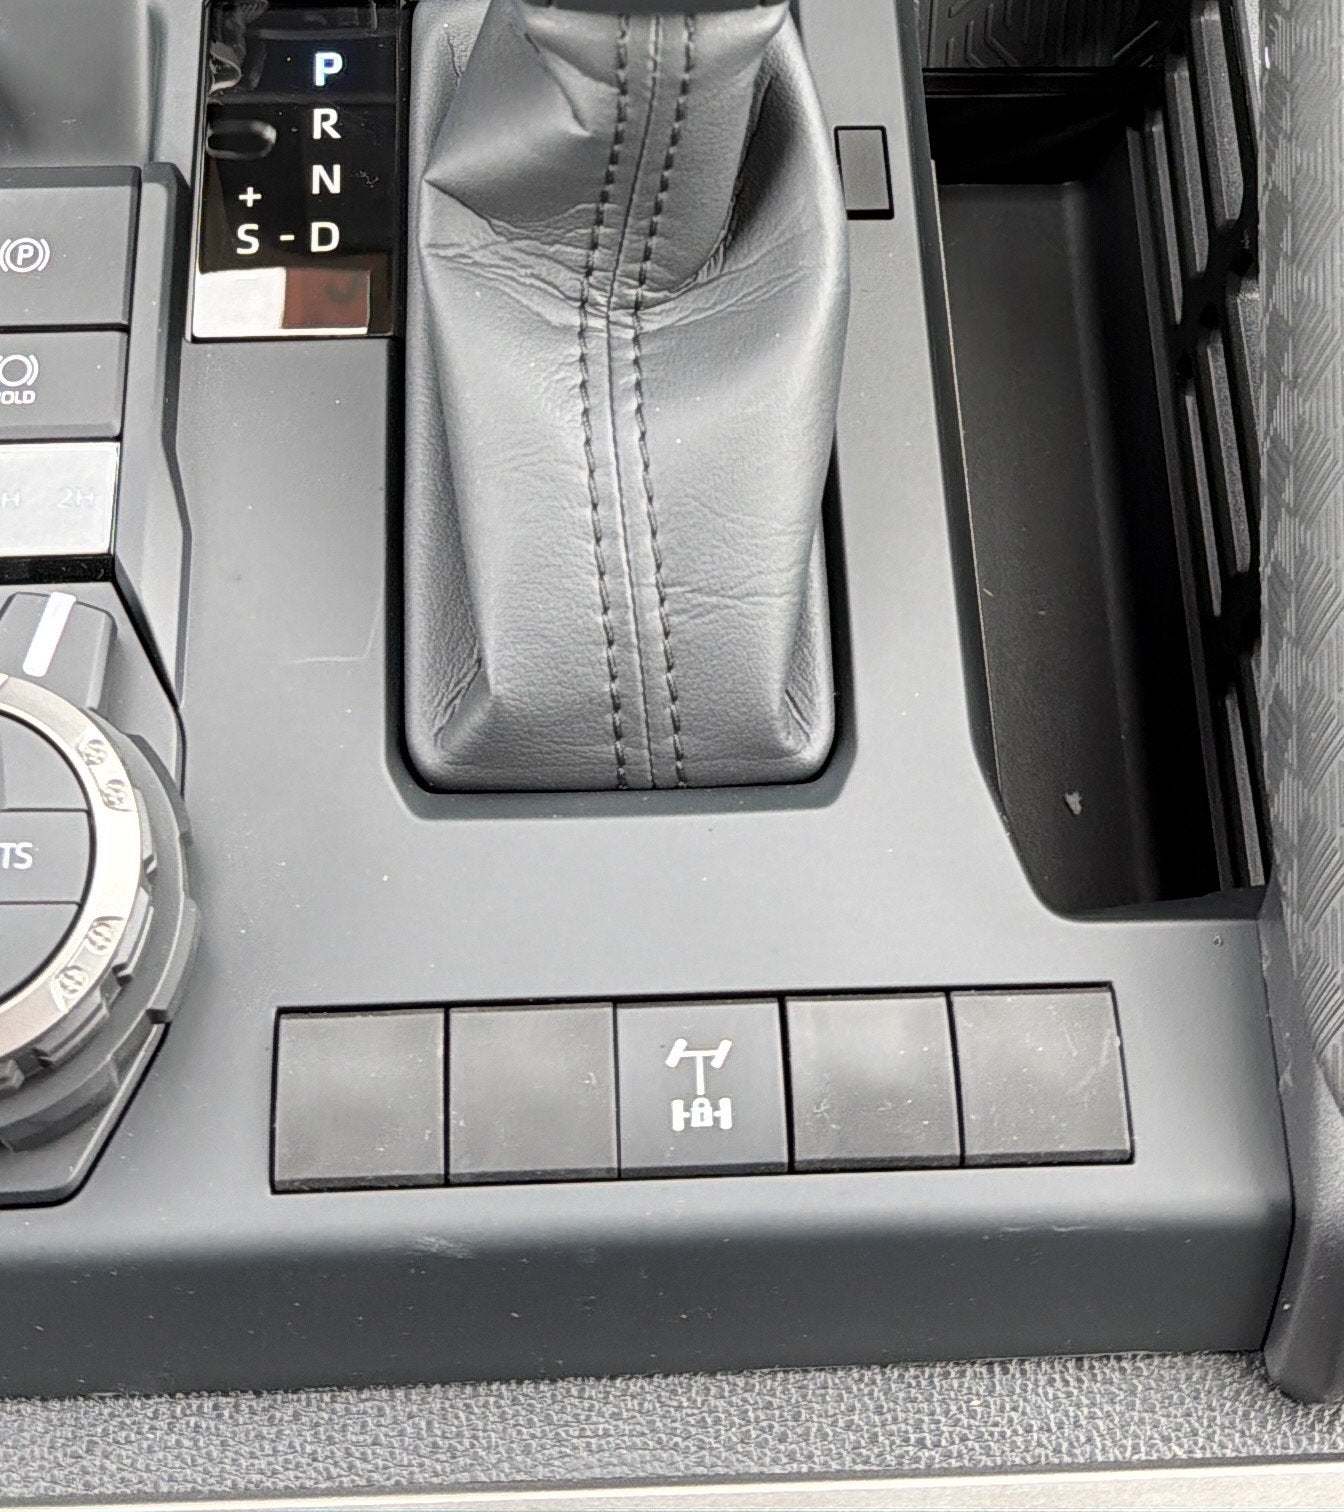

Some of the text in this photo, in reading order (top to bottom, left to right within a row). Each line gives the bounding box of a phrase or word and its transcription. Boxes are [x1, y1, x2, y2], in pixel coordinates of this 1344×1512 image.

[314, 51, 344, 87] P
[312, 107, 342, 140] R
[311, 163, 341, 194] N
[235, 222, 260, 255] S
[310, 221, 341, 253] D
